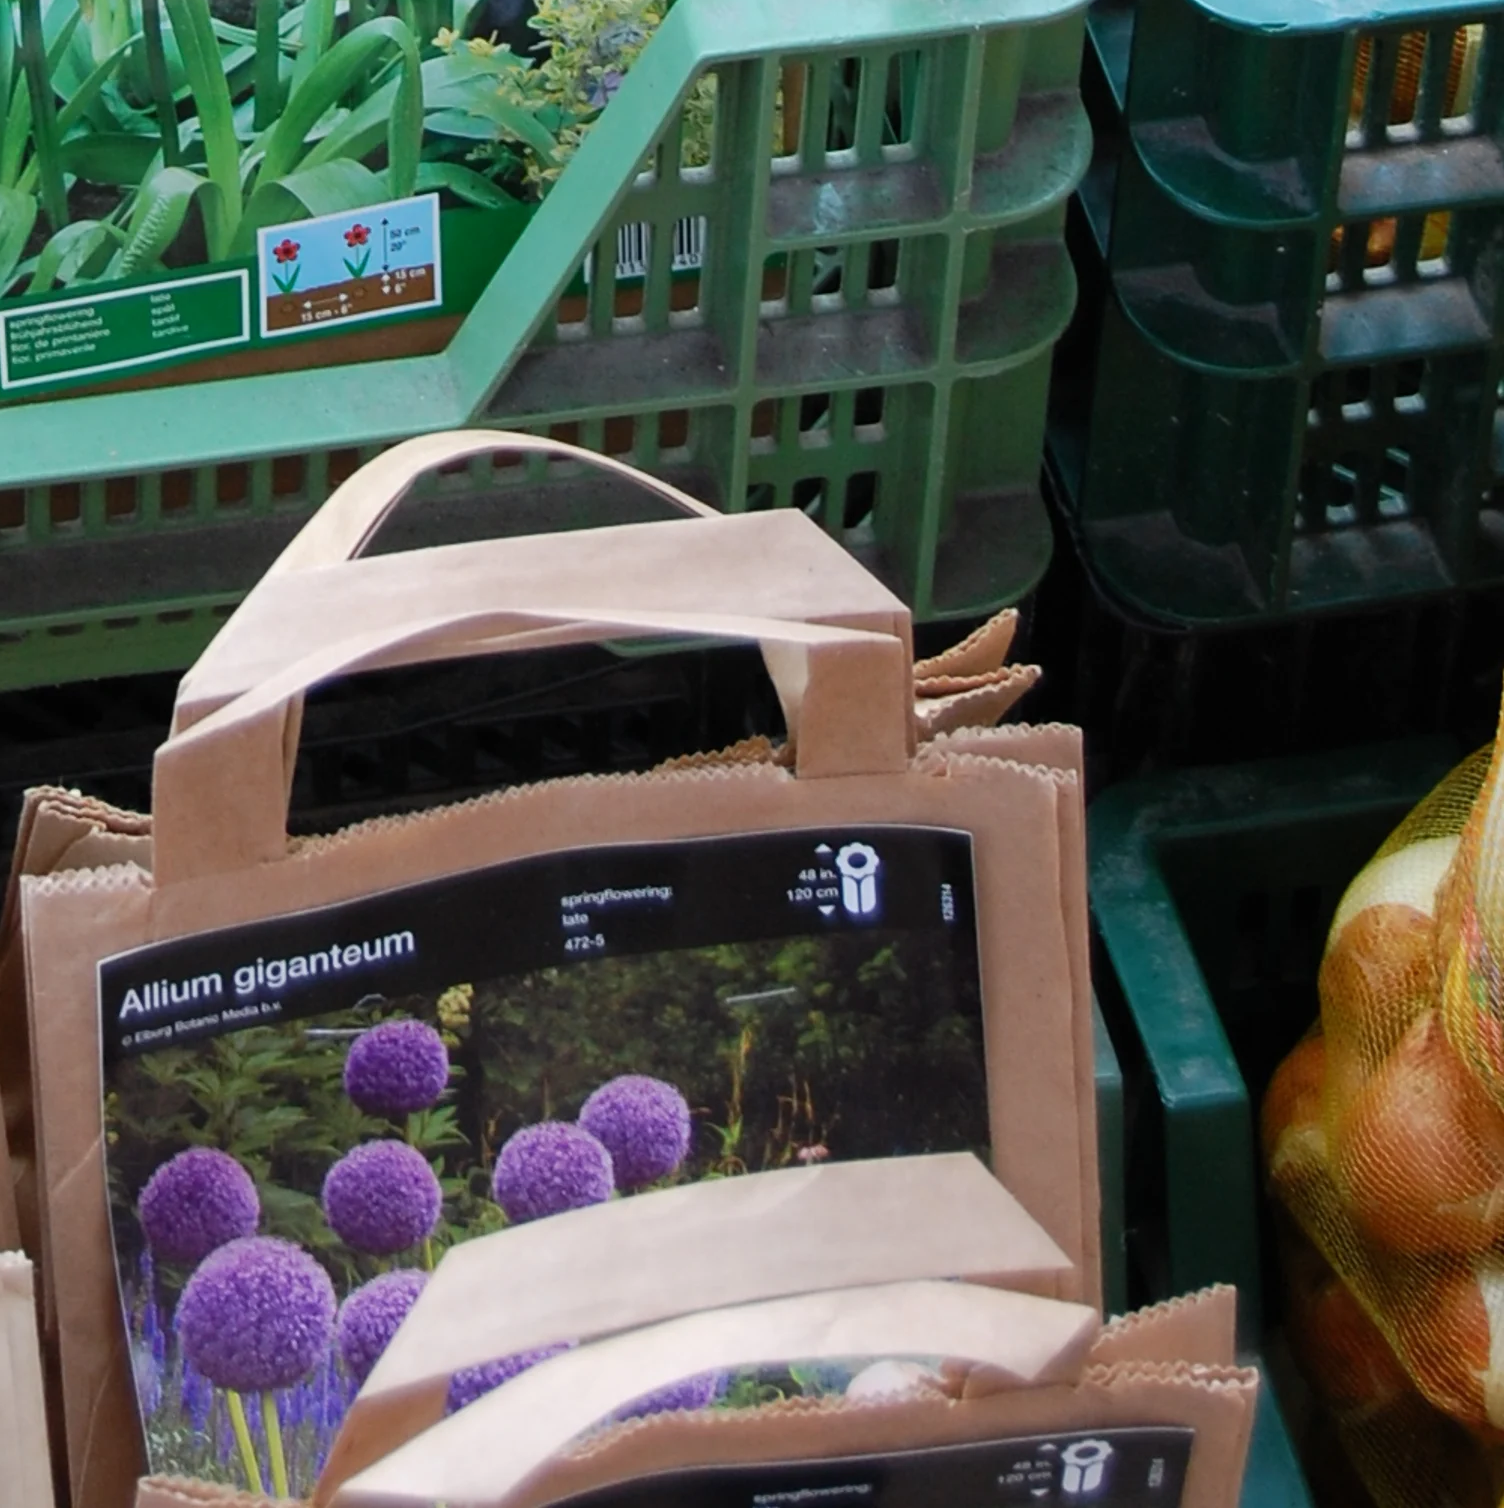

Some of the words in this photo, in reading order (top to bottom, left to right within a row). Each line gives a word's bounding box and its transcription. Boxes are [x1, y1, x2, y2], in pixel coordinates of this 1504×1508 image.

[300, 311, 314, 323] 15
[314, 308, 333, 320] cm
[798, 868, 817, 882] 48
[819, 867, 838, 881] in.
[561, 885, 674, 909] springflowering:
[787, 887, 813, 902] 120
[816, 886, 840, 899] cm
[562, 912, 589, 927] late
[564, 934, 606, 951] 472-5
[119, 972, 223, 1019] Allium
[234, 930, 415, 995] giganteum
[174, 1013, 220, 1032] Botanic
[221, 1005, 259, 1022] Media
